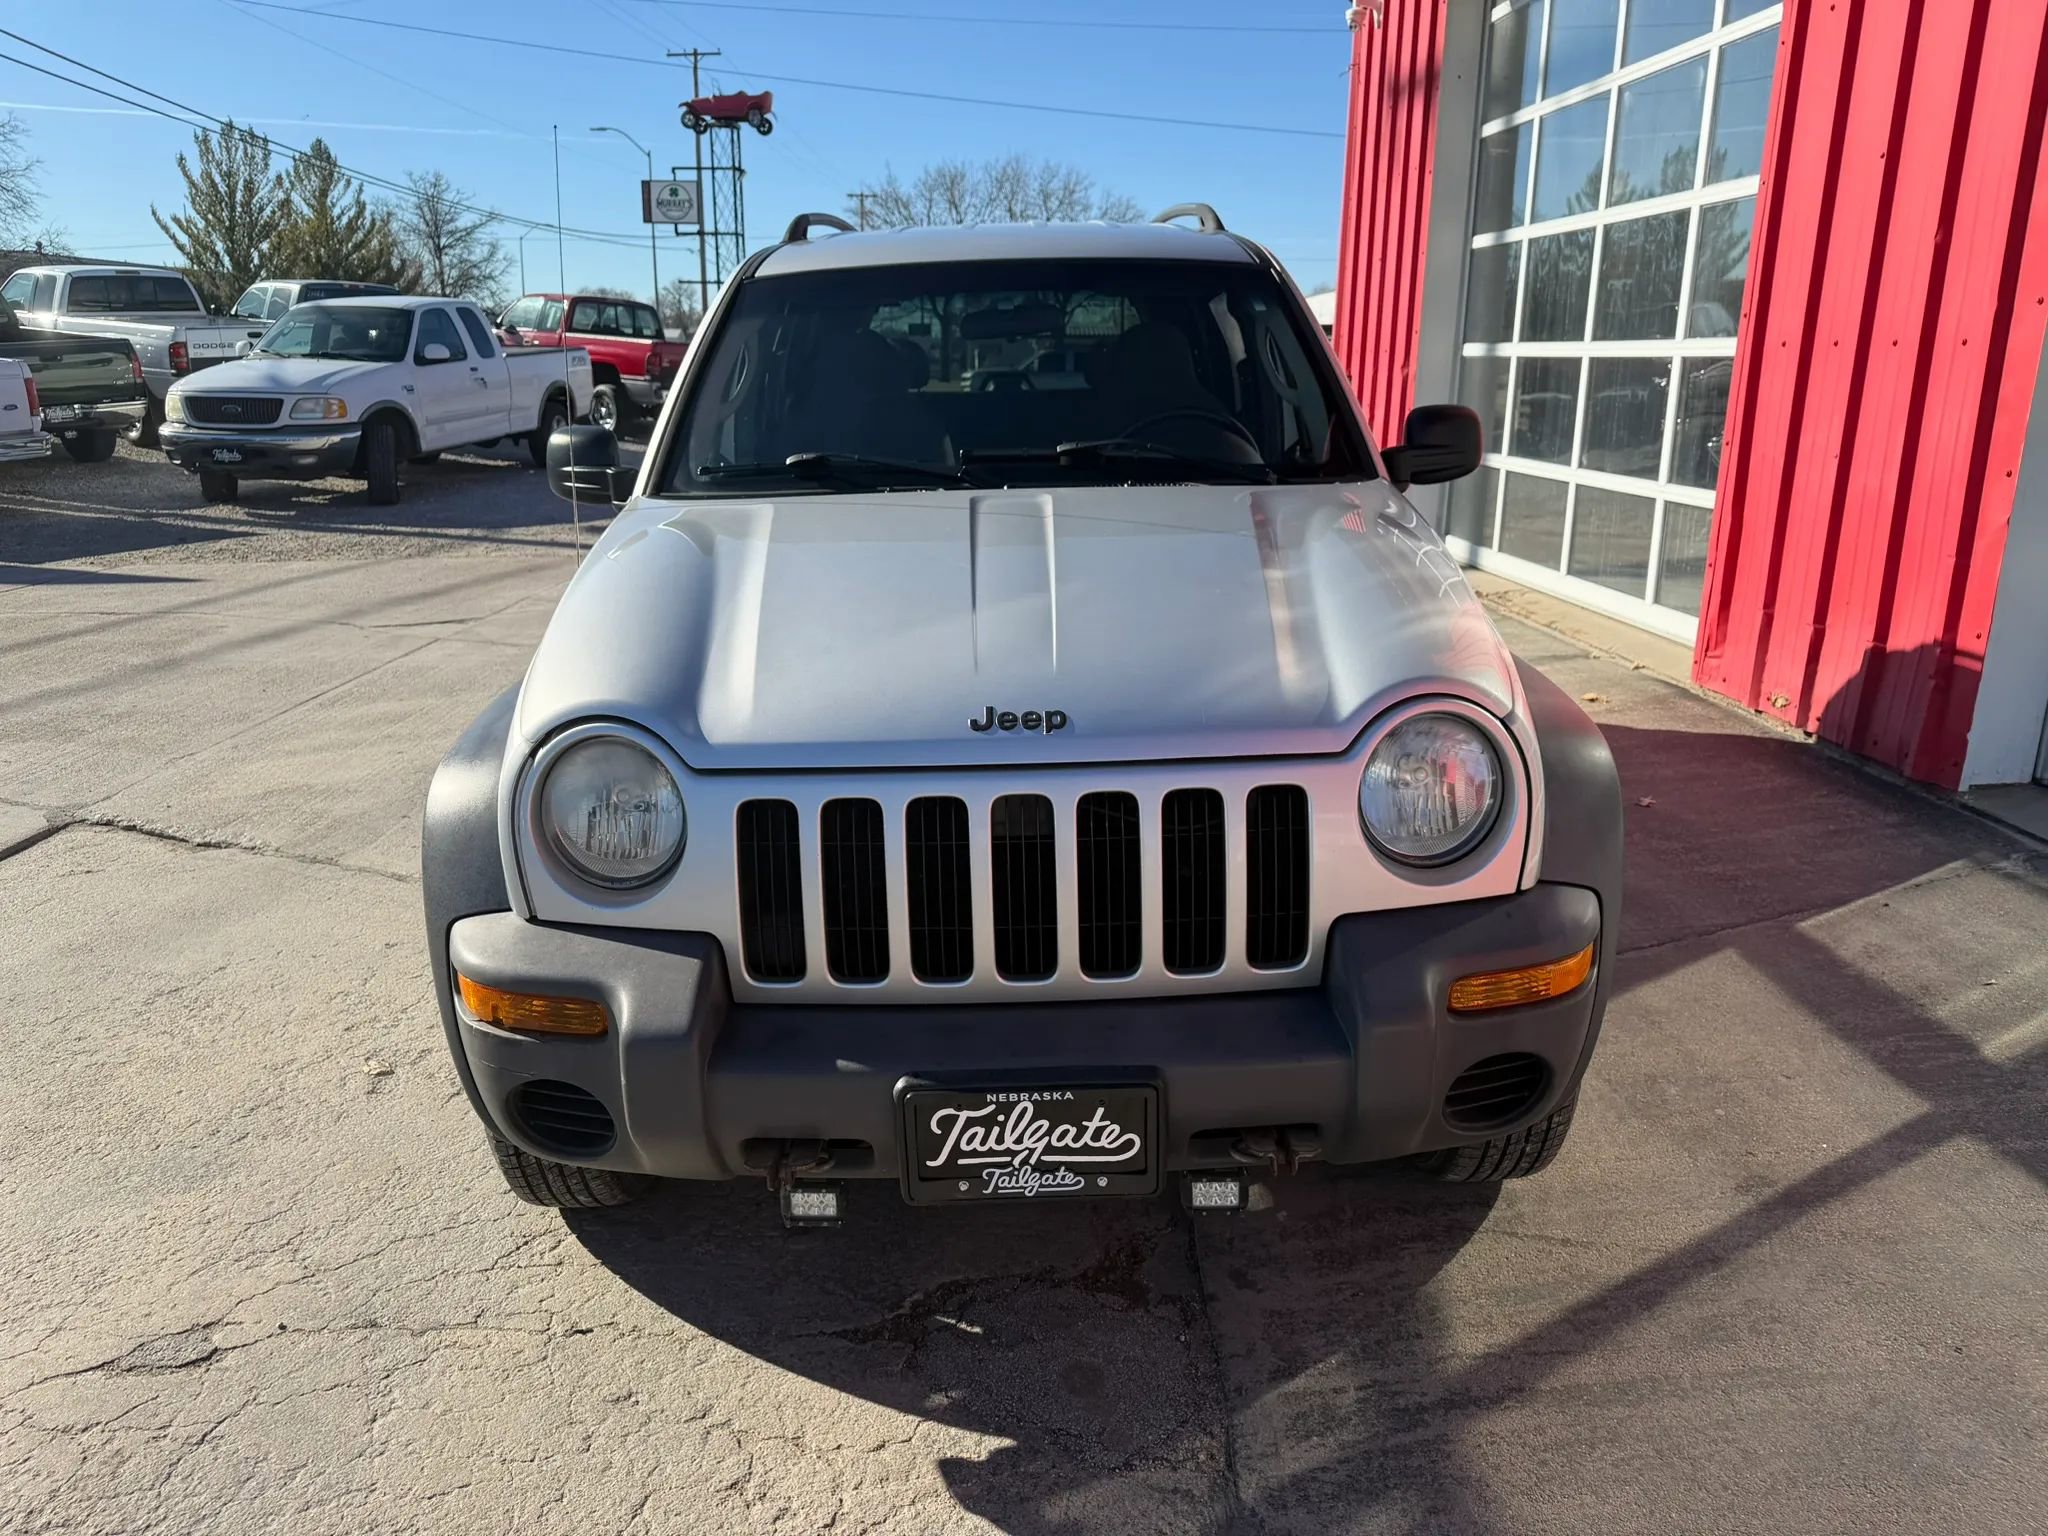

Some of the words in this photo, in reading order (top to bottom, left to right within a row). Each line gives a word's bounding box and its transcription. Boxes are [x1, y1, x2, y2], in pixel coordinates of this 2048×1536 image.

[968, 704, 1067, 735] Jeep
[986, 1091, 1074, 1102] NEBRASKA
[927, 1101, 1141, 1168] Tailgate
[982, 1165, 1085, 1197] Tailgate
